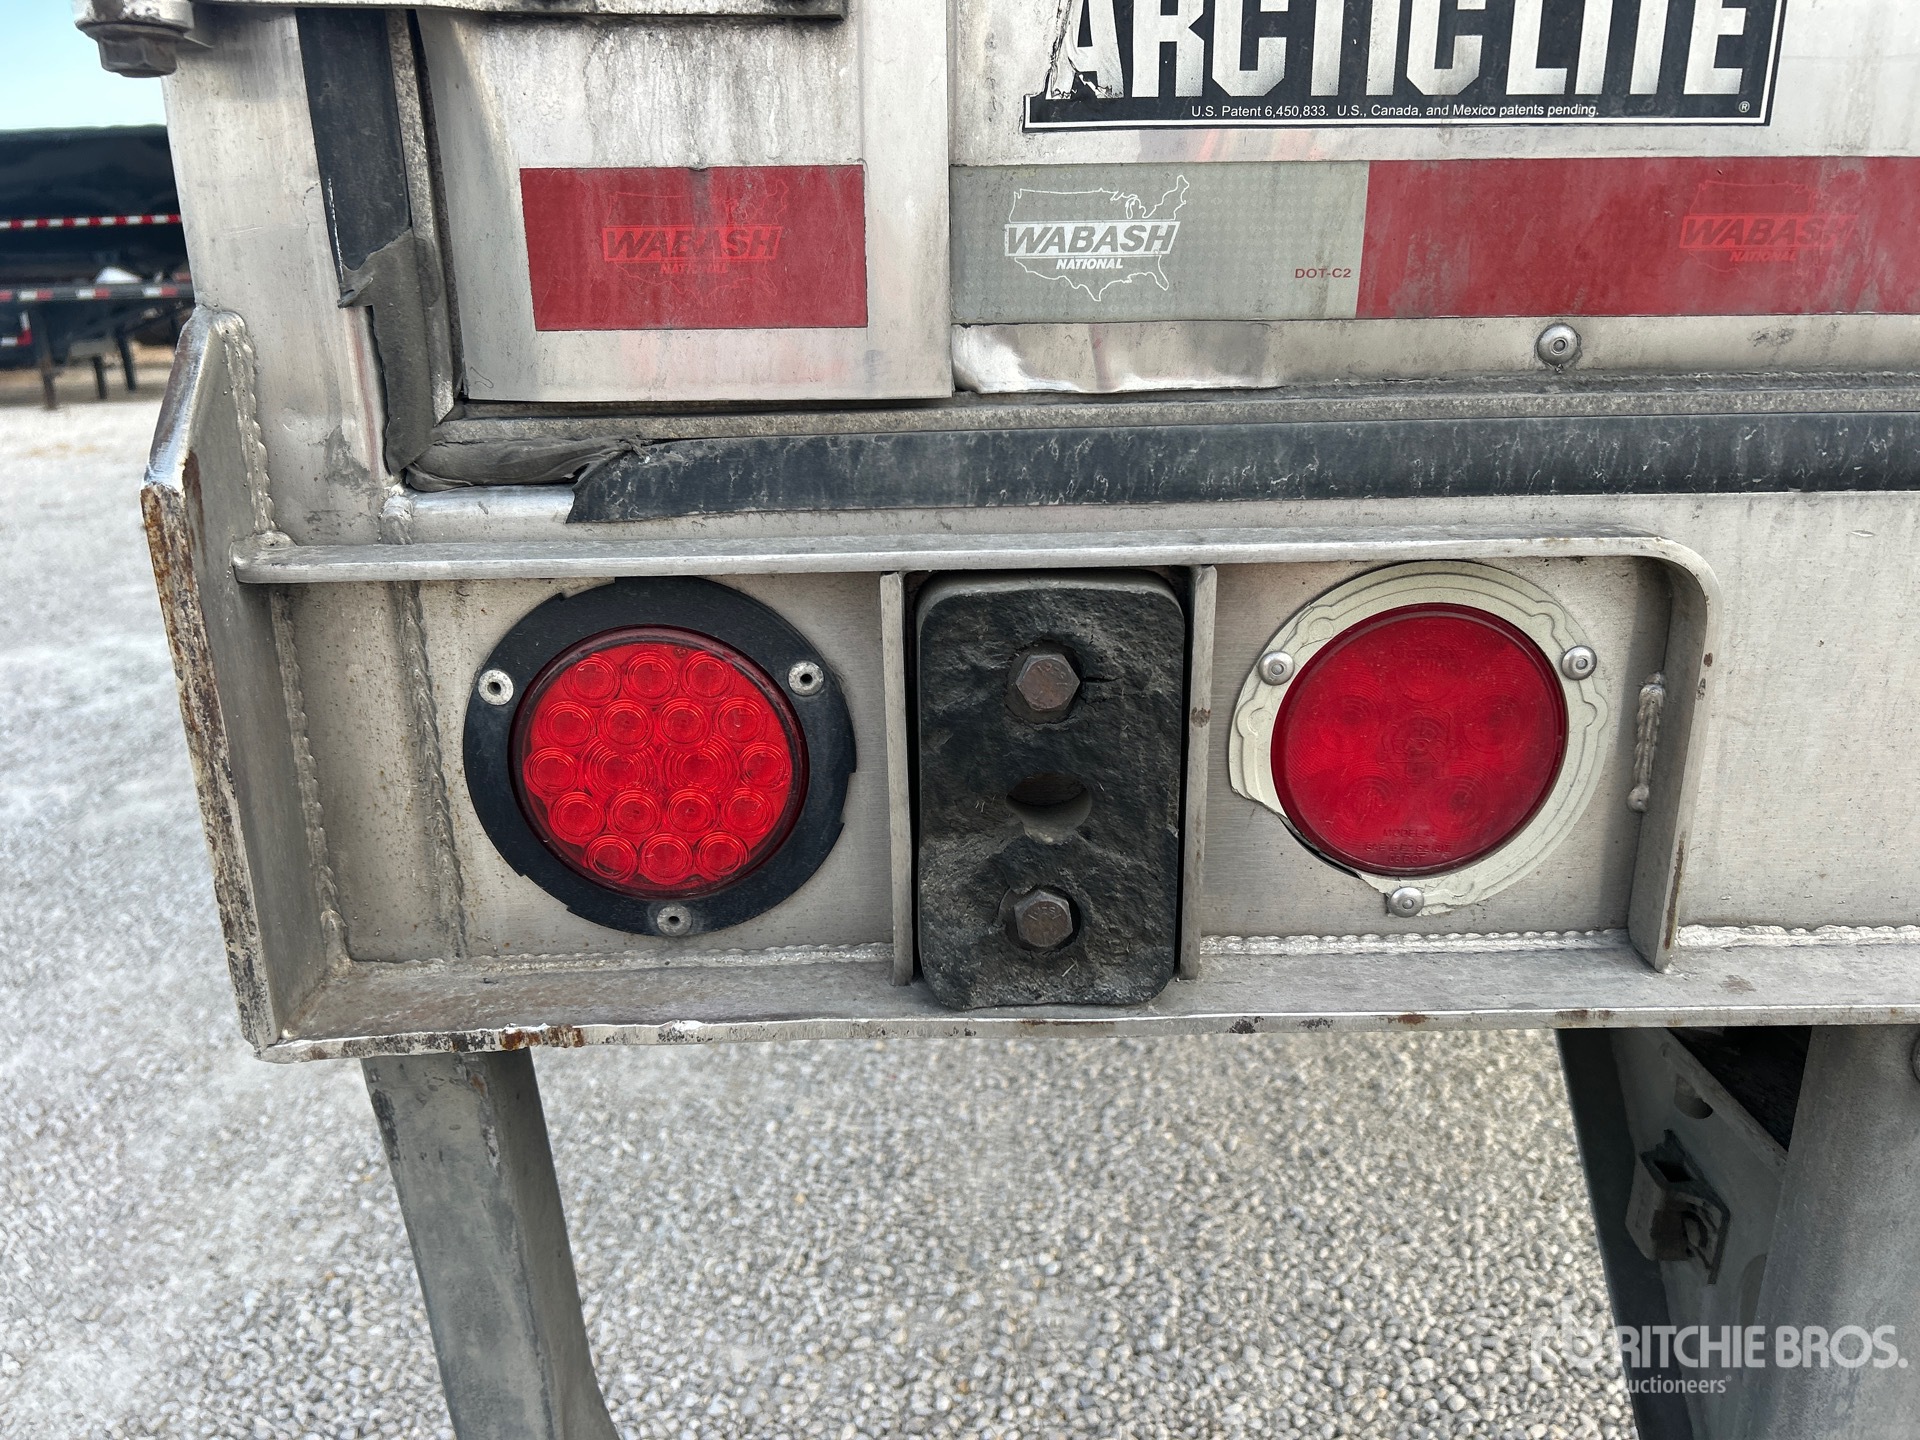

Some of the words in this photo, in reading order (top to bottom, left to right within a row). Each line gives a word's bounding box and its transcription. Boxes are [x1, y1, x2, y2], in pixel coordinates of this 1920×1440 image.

[1191, 105, 1217, 117] U.S.
[1222, 105, 1261, 117] Patent
[1264, 105, 1329, 118] 6,450,833.
[1337, 104, 1366, 118] U.S.,
[1371, 104, 1422, 117] Canada,
[1426, 104, 1449, 116] and
[1452, 104, 1496, 116] Mexico
[1499, 104, 1544, 117] patents
[1547, 104, 1600, 118] pending.
[1007, 224, 1177, 255] WABASH
[1682, 218, 1850, 246] WABASH
[605, 228, 780, 260] WABASH
[1055, 258, 1124, 270] NATIONAL
[1294, 268, 1352, 279] DOT-C2
